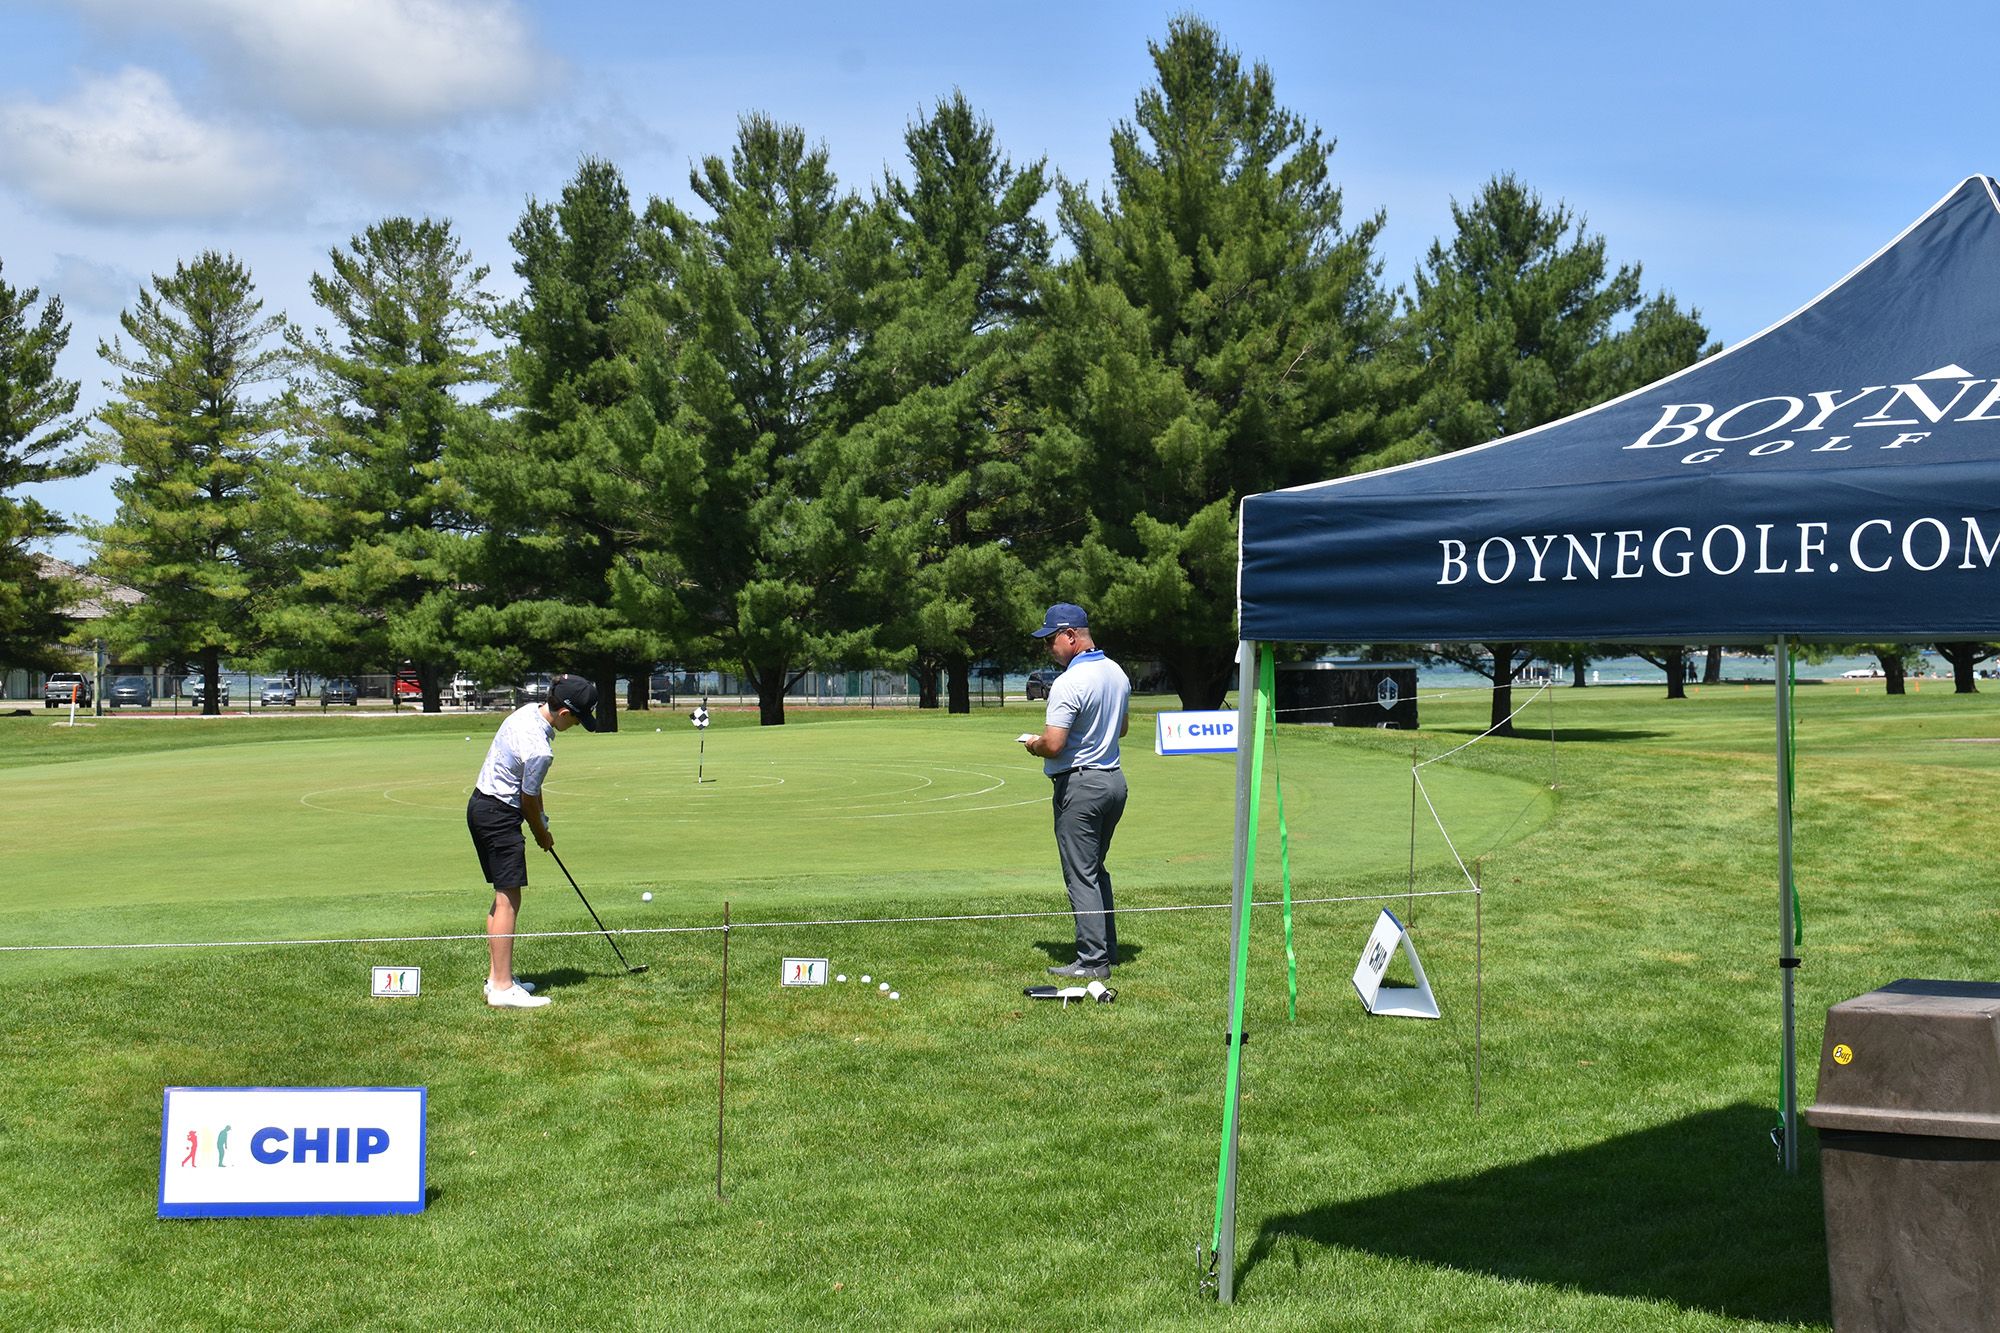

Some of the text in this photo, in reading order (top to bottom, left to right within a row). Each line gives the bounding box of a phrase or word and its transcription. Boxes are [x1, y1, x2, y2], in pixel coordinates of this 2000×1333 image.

[1680, 431, 1932, 464] GOLF
[1436, 516, 2000, 585] BOYNEGOLF.COM
[1188, 723, 1234, 737] CHIP
[1369, 942, 1387, 974] CHIP
[250, 1126, 390, 1165] CHIP
